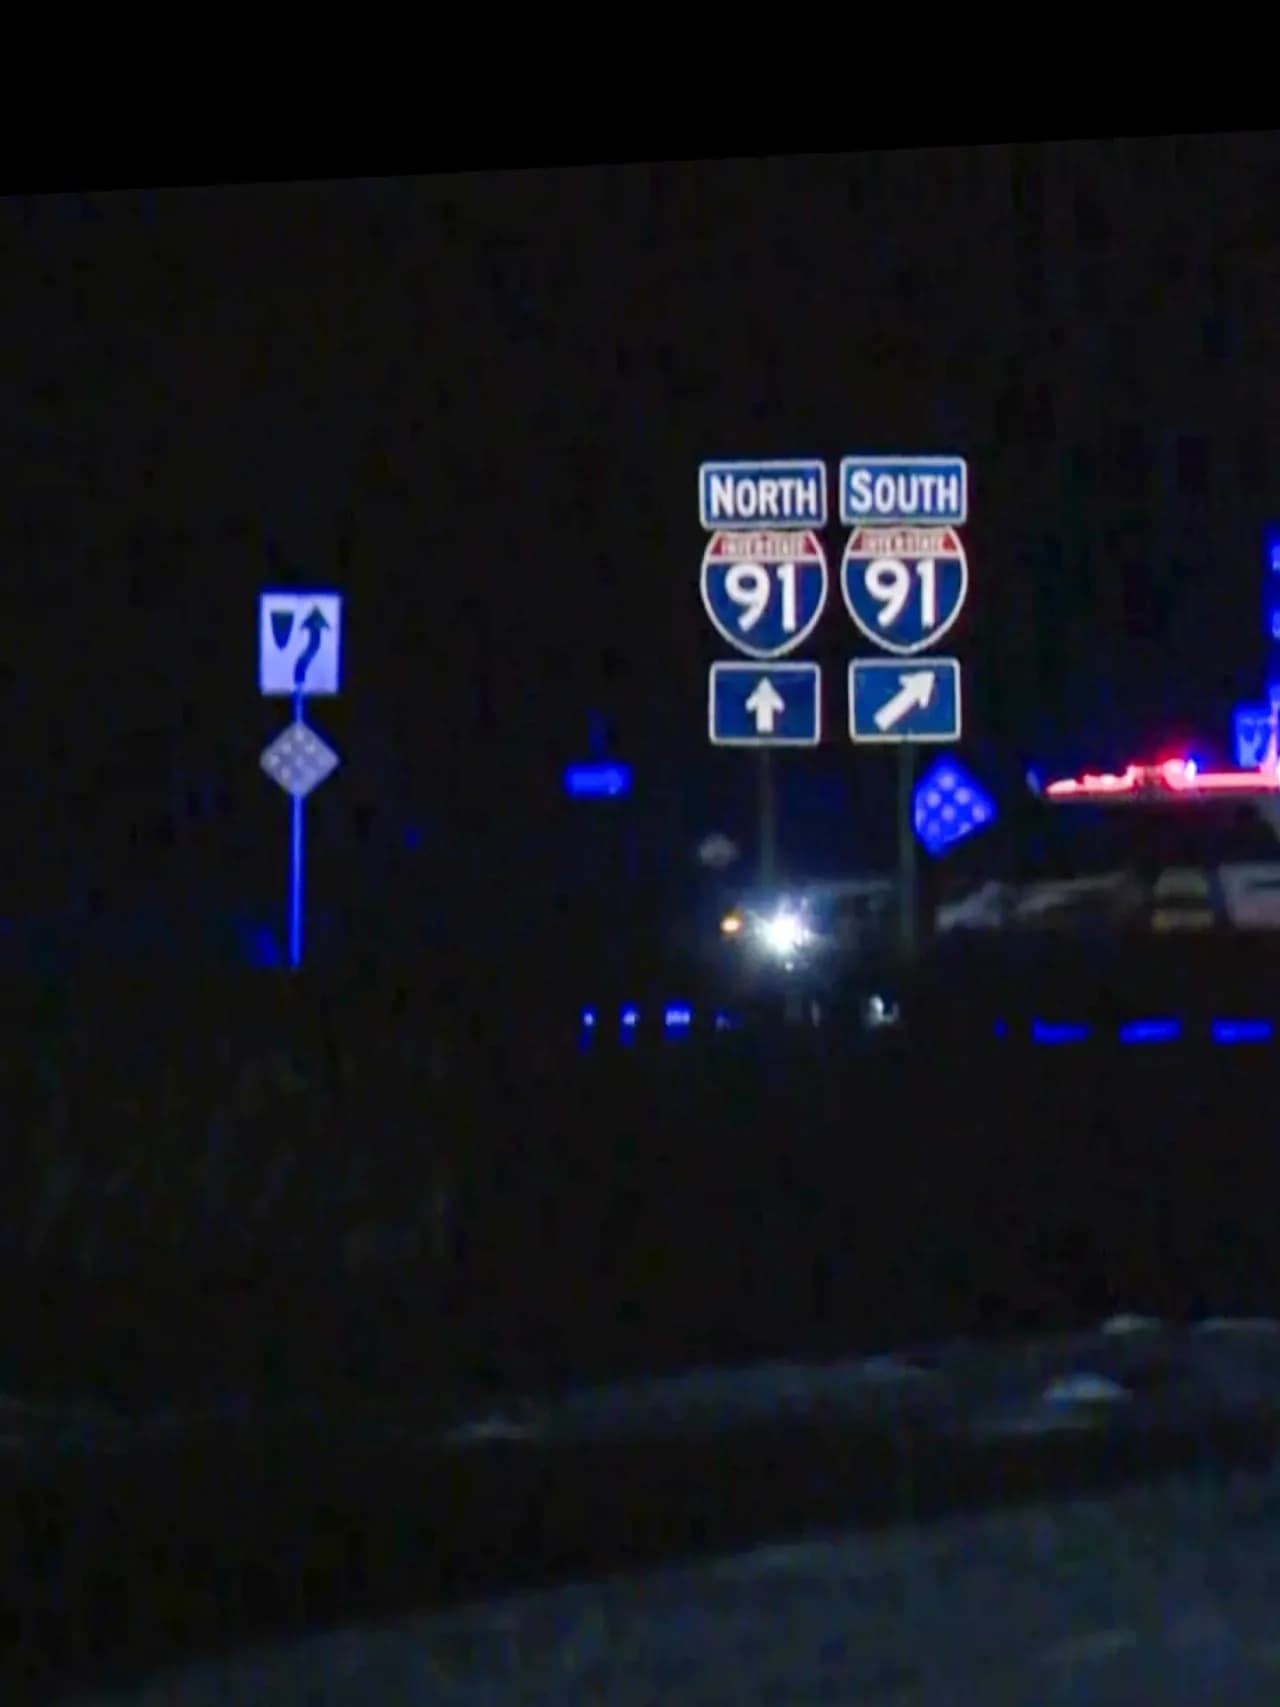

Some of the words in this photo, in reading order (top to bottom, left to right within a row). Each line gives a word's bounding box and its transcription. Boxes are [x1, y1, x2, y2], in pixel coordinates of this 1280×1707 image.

[709, 474, 817, 518] NORTH
[850, 469, 958, 513] SOUTH
[725, 563, 796, 632] 91
[865, 559, 936, 628] 91
